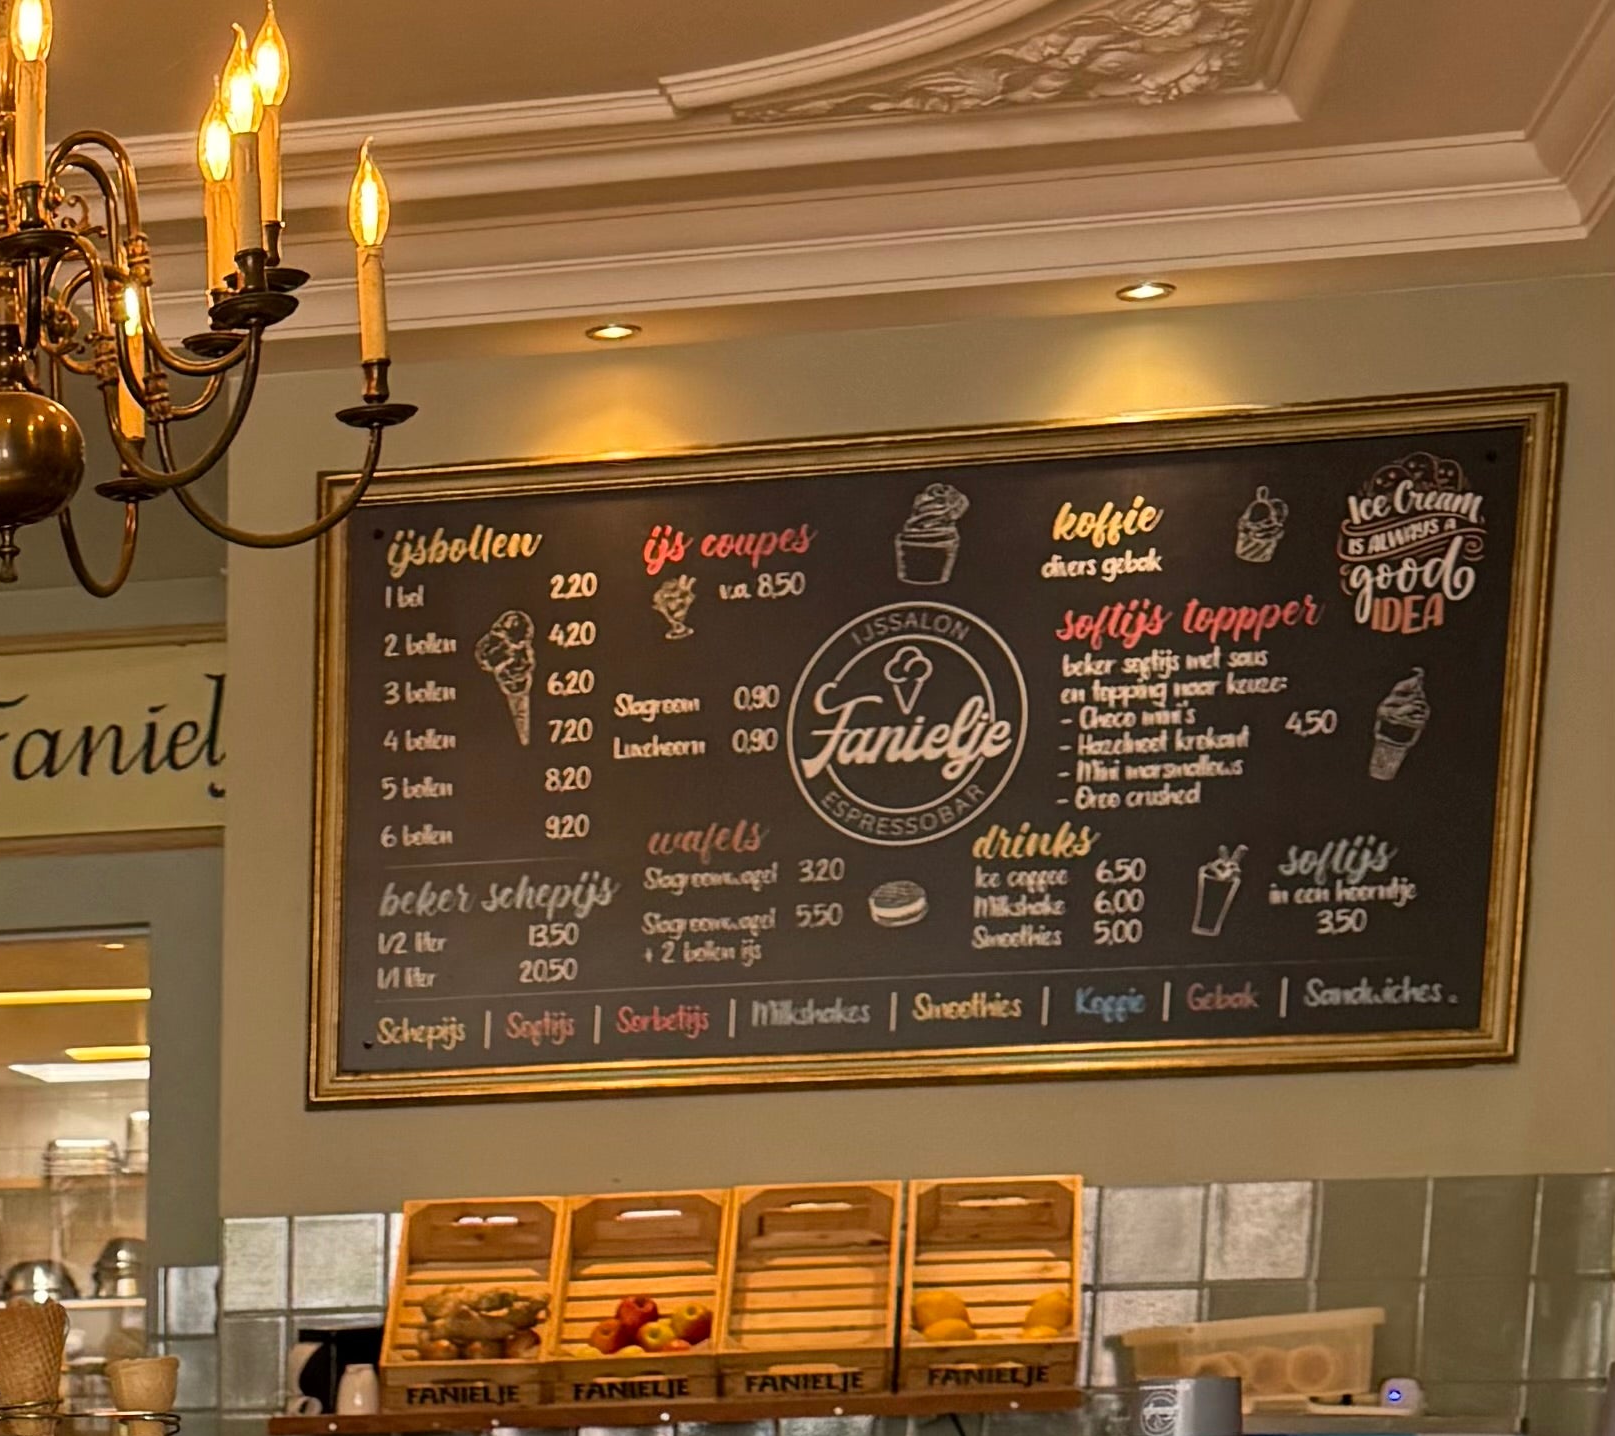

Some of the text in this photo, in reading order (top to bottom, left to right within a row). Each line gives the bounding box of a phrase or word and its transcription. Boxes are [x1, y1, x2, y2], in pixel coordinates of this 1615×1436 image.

[1348, 480, 1483, 524] Ice Cream
[1052, 496, 1164, 548] koffie
[387, 524, 542, 579] ijsbollen
[643, 524, 816, 575] ijs coupes
[1349, 535, 1475, 624] good
[851, 612, 970, 646] IJSSALON
[1055, 599, 1172, 651] softijs
[1371, 592, 1444, 634] IDEA
[385, 635, 399, 657] 2
[405, 632, 456, 656] bollen
[385, 682, 399, 704] 3
[405, 681, 456, 703] bollen
[1060, 686, 1085, 704] en
[384, 731, 399, 752] 4
[405, 729, 456, 752] bollen
[800, 682, 1012, 780] Fanielje
[382, 777, 397, 800] 5
[402, 777, 453, 799] bollen
[821, 783, 985, 836] ESPRESSOBAR
[380, 827, 397, 848] 6
[402, 825, 452, 848] bollen
[647, 819, 770, 866] wafels
[971, 821, 1101, 859] drinks
[974, 865, 1000, 888] Ice
[1278, 834, 1399, 885] softijs
[379, 871, 622, 920] beker schepijs
[661, 941, 675, 964] 2
[407, 1382, 520, 1406] FANIELJE
[573, 1375, 688, 1401] FANIELJE
[744, 1369, 864, 1394] FANIELJE
[928, 1364, 1049, 1388] FANIELJE
